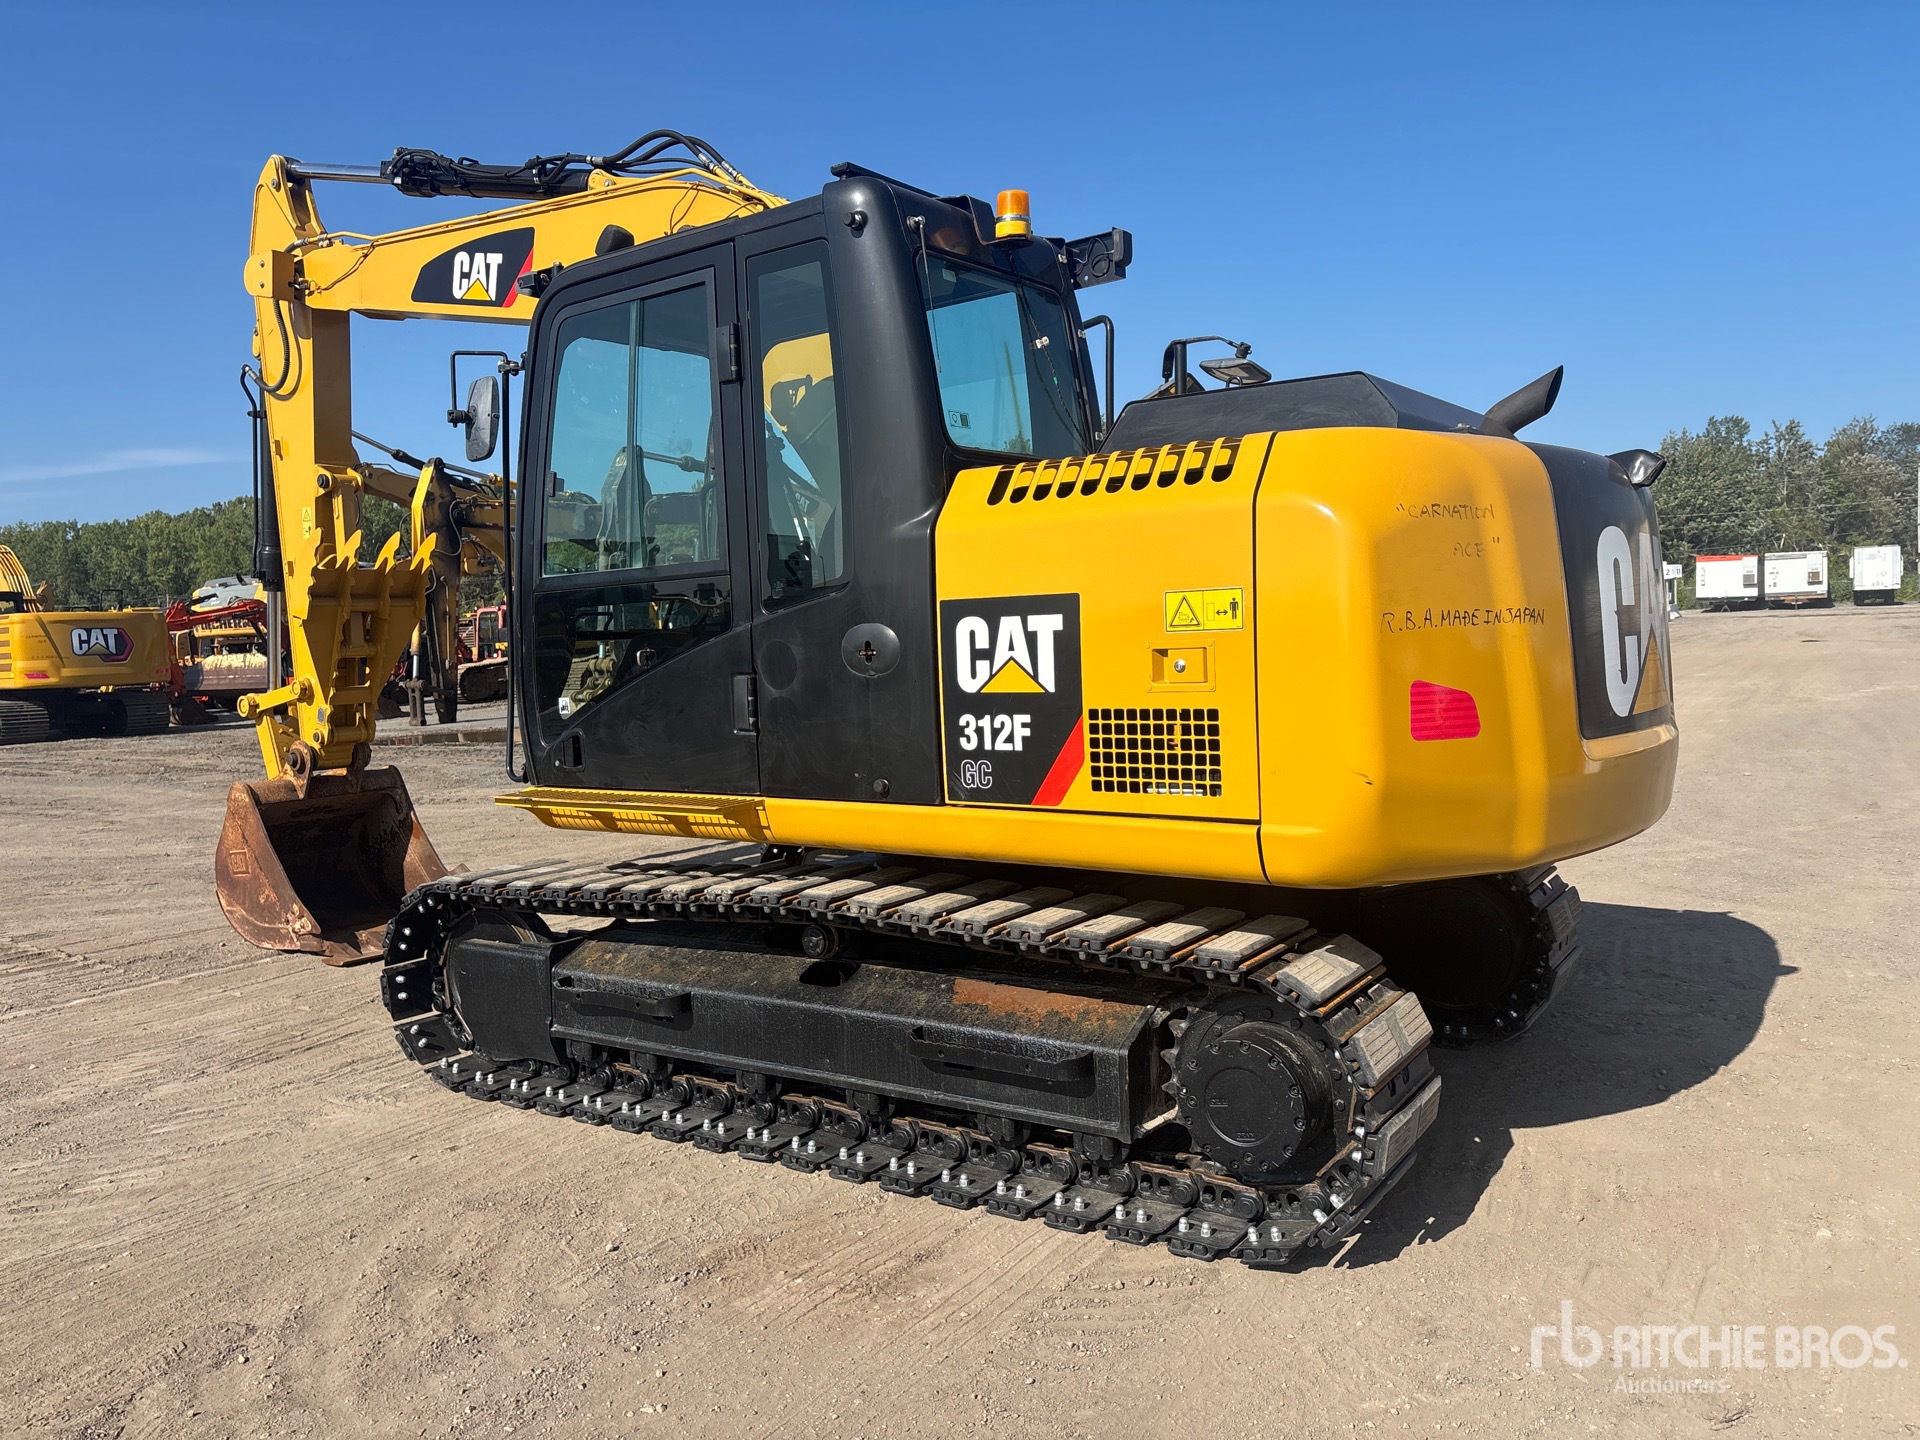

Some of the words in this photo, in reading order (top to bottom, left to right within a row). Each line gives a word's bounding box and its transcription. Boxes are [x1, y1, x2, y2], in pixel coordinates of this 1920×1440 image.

[453, 251, 503, 301] CAT
[71, 628, 118, 655] CAT
[956, 614, 1063, 693] CAT
[959, 713, 1031, 751] 312F
[961, 759, 993, 789] GC
